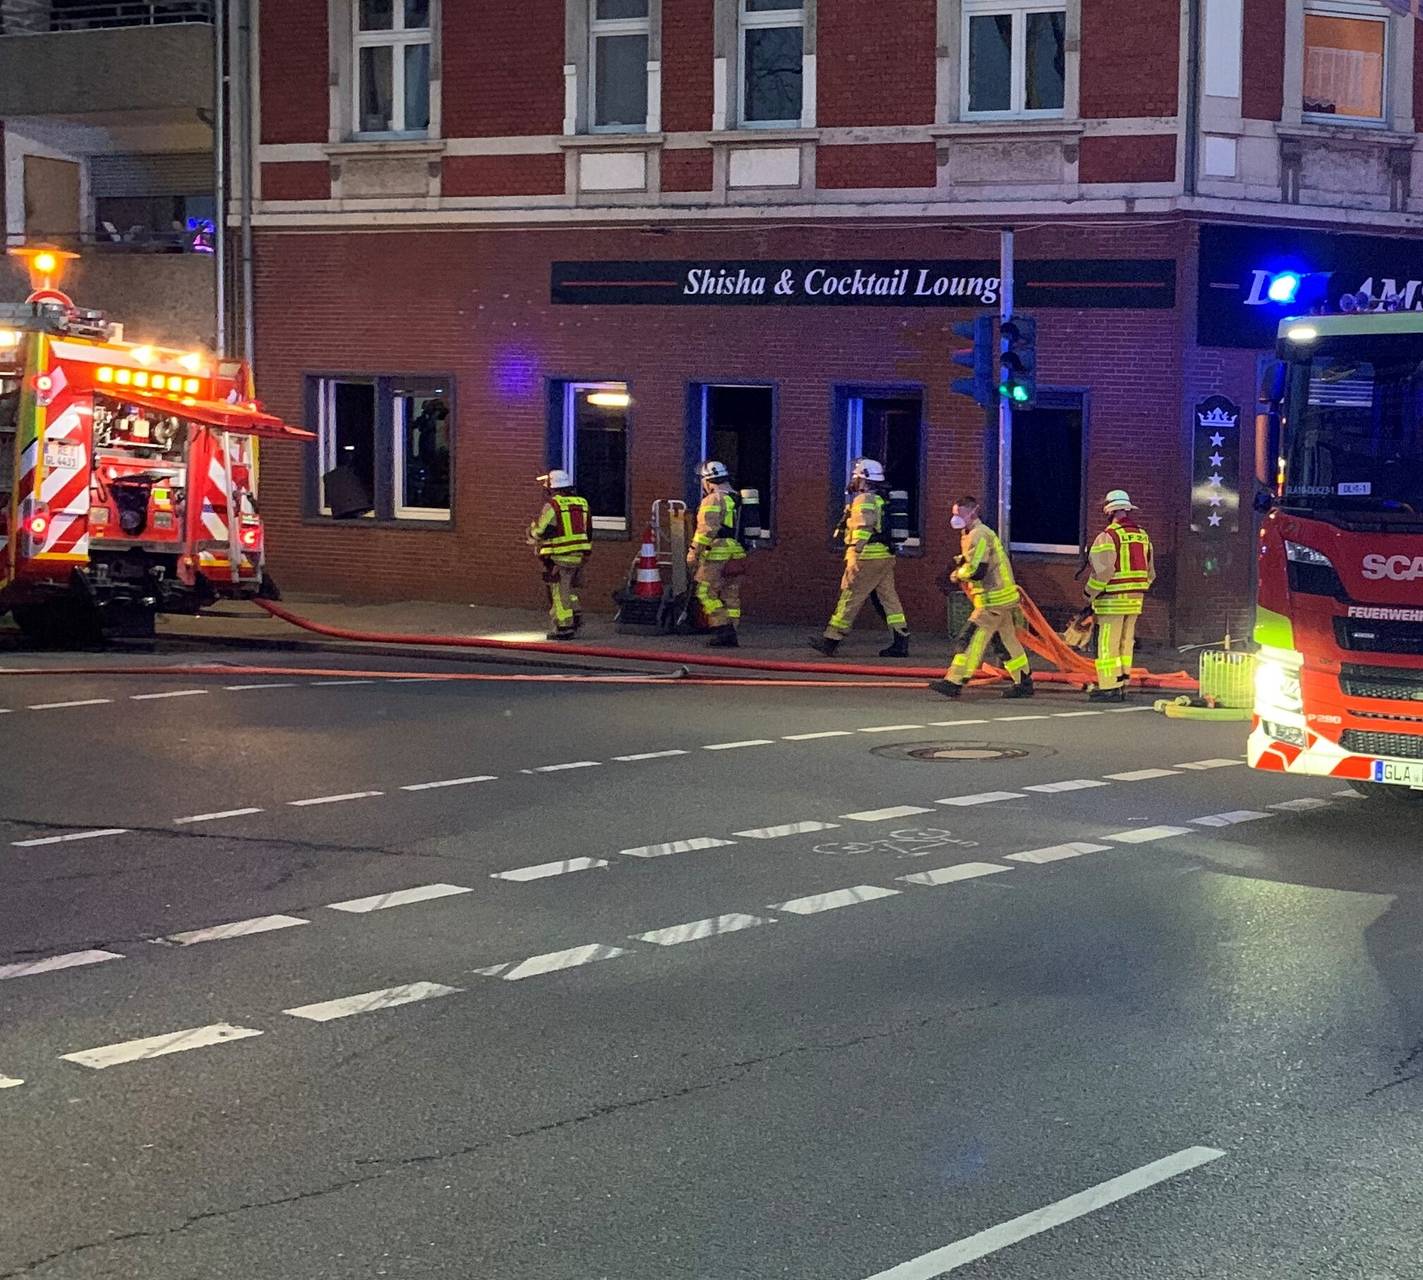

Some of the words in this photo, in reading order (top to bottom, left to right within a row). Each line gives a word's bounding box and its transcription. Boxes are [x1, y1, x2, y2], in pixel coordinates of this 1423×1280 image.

[683, 268, 766, 295] Shisha
[774, 267, 797, 296] &
[803, 268, 907, 296] Cocktail
[914, 269, 1003, 304] Loung
[1384, 763, 1411, 783] GLA
